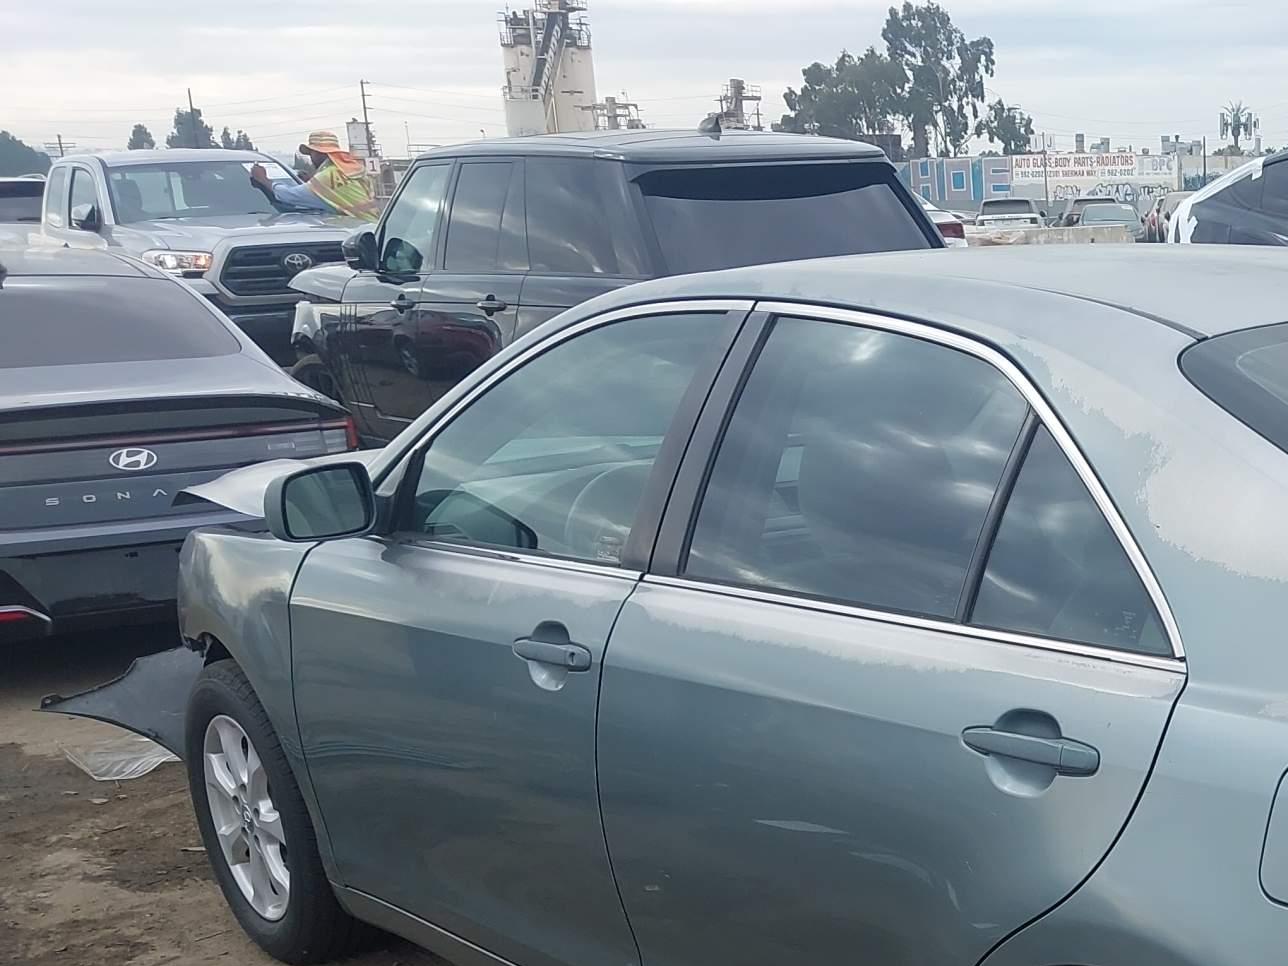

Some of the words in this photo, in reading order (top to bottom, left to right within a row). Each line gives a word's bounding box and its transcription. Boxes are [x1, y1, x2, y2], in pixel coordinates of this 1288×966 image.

[369, 160, 377, 172] 1
[1014, 157, 1031, 169] AUTO
[1086, 169, 1097, 177] WAY
